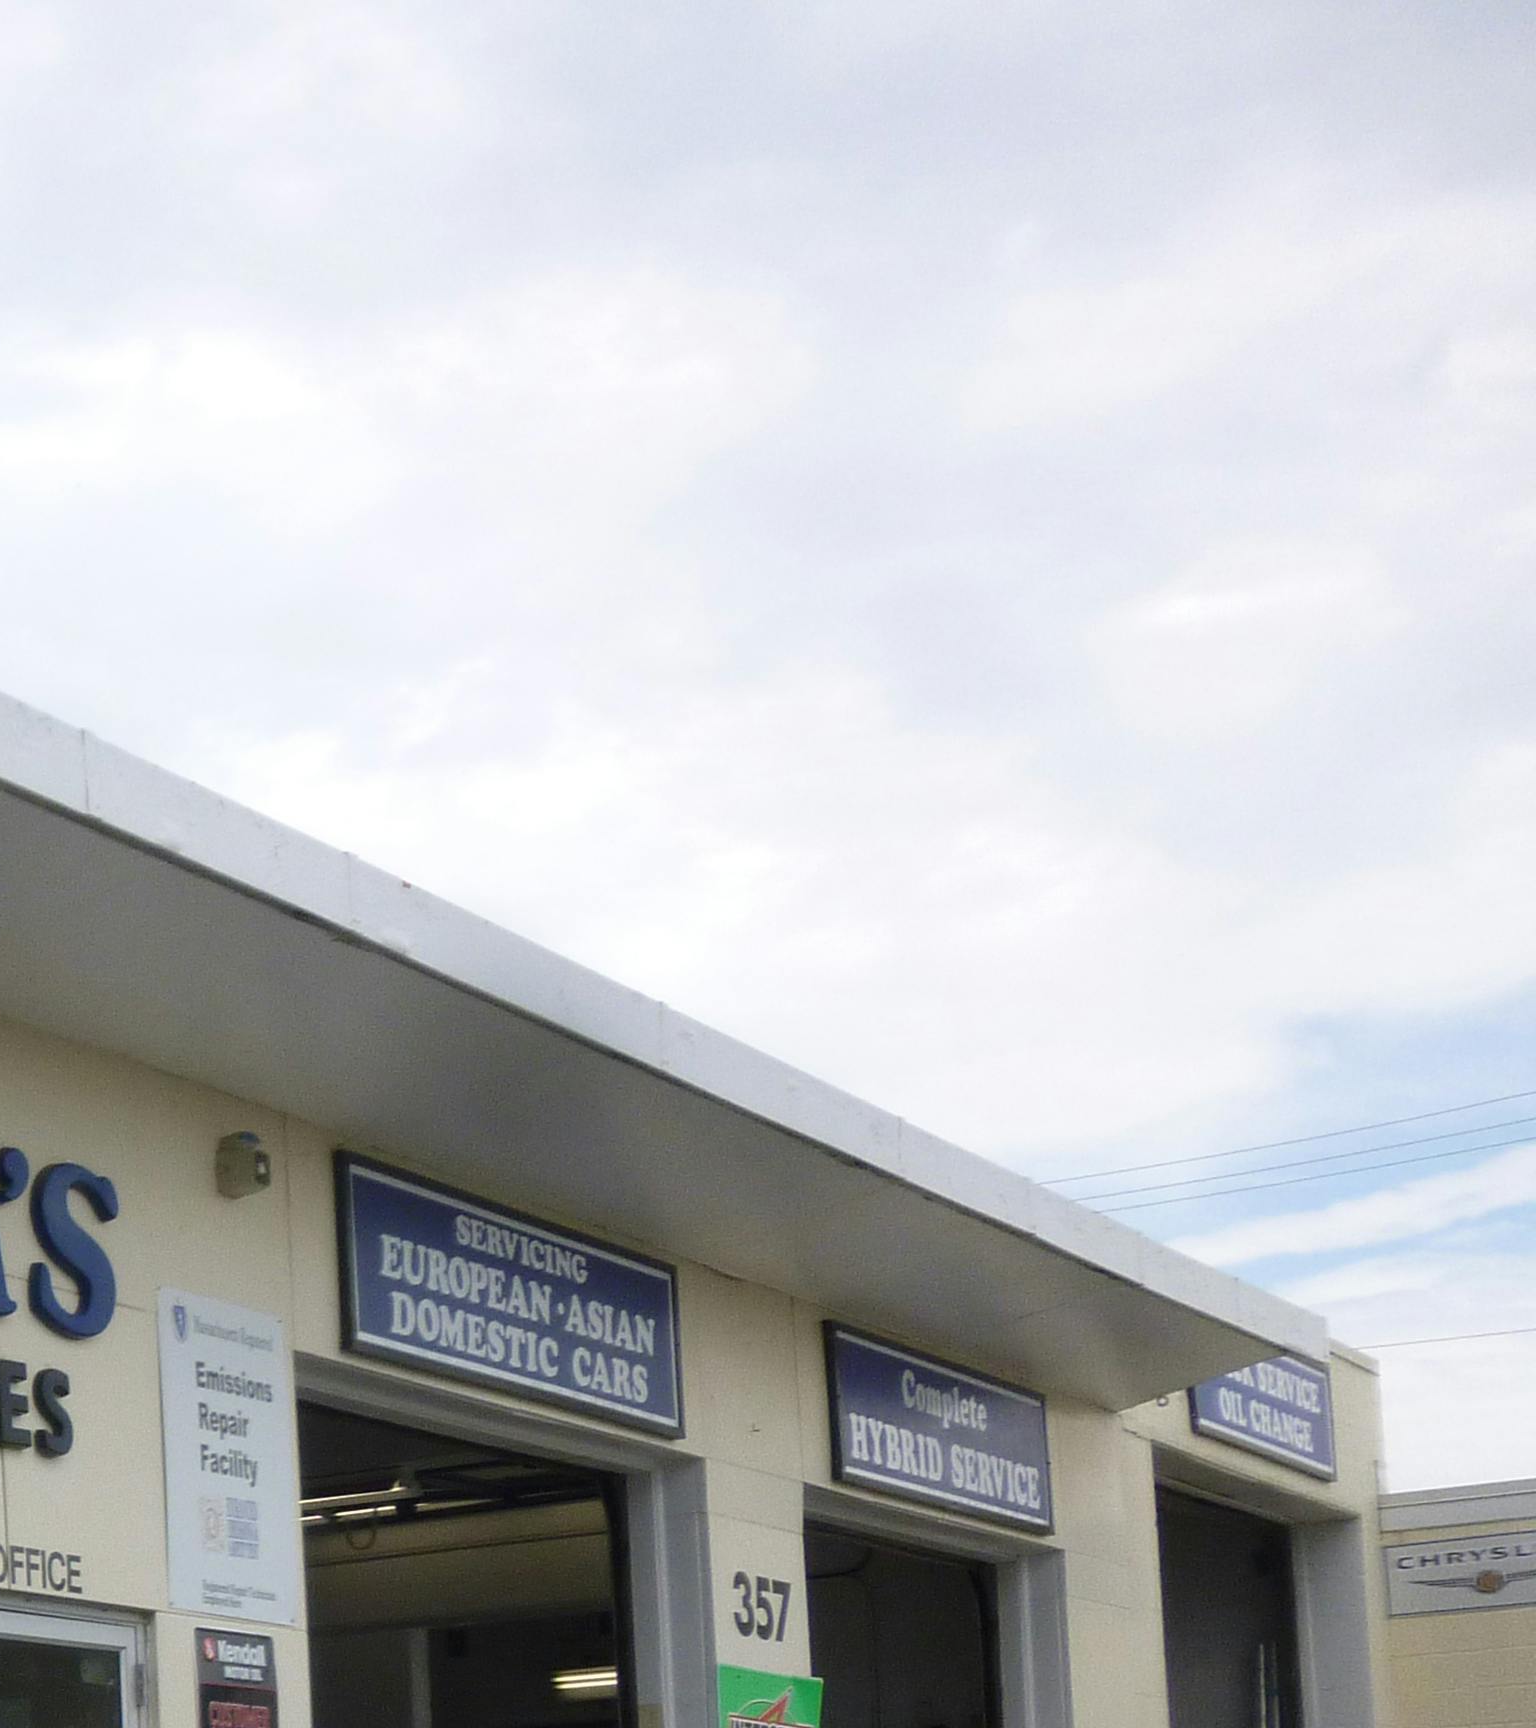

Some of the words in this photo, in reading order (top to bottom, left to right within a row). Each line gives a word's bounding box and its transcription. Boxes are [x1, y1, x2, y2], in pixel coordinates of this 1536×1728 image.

[456, 1214, 589, 1285] SERVICING
[389, 1291, 559, 1378] DOMESTIC
[572, 1346, 649, 1403] CARS
[195, 1361, 273, 1403] Emissions
[901, 1369, 988, 1431] Complete
[1257, 1363, 1321, 1413] SERVICE
[197, 1402, 250, 1440] Repair
[1220, 1387, 1247, 1427] OIL
[1250, 1399, 1314, 1453] CHANGE
[200, 1443, 259, 1488] Facility
[848, 1411, 943, 1483] HYBRID
[950, 1443, 1041, 1510] SERVICE
[1396, 1544, 1534, 1571] CHRYSL
[732, 1570, 792, 1643] 357
